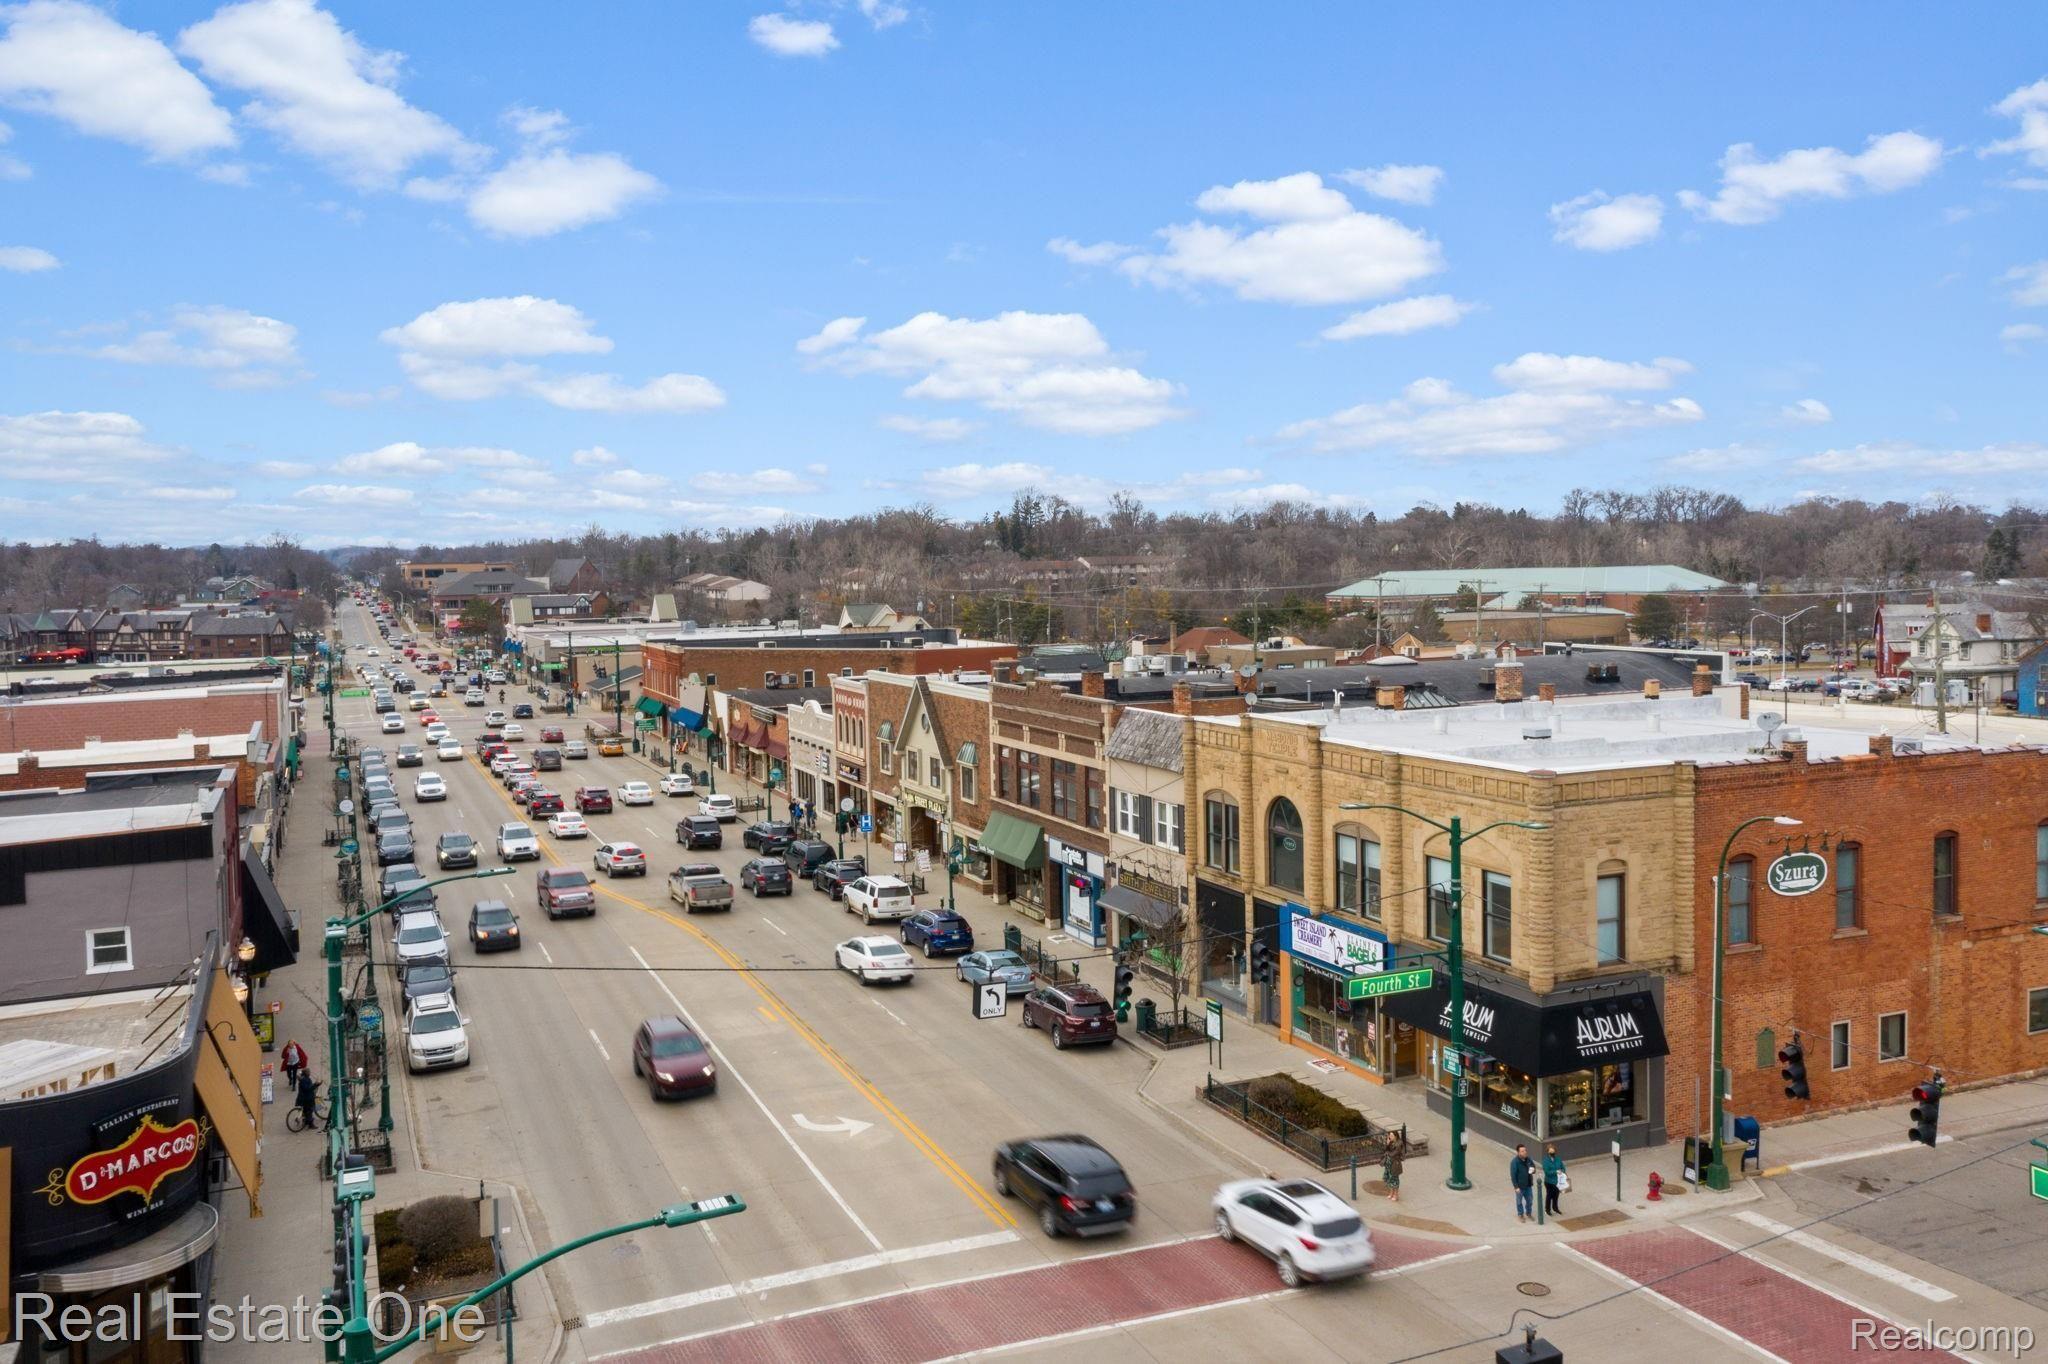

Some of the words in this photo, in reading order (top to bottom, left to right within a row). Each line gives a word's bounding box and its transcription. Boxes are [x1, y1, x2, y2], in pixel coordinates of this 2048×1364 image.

[861, 815, 871, 827] H
[1119, 873, 1139, 890] SMITH
[1775, 863, 1818, 882] Szura
[1293, 916, 1309, 934] SWEET
[1309, 921, 1327, 938] ISLAND
[1297, 929, 1323, 948] CREAMERY
[1346, 943, 1377, 967] BAGELS
[1361, 977, 1402, 995] Fourth
[1408, 973, 1421, 988] St
[982, 1007, 1002, 1016] ONLY
[1576, 1012, 1640, 1044] AURUM
[1580, 1045, 1609, 1057] DESIGN
[1611, 1039, 1643, 1053] JEWELRY
[98, 1111, 135, 1132] ITALIAN
[136, 1098, 180, 1116] RESTAURANT
[126, 1206, 149, 1220] WINE
[149, 1199, 165, 1212] BAR
